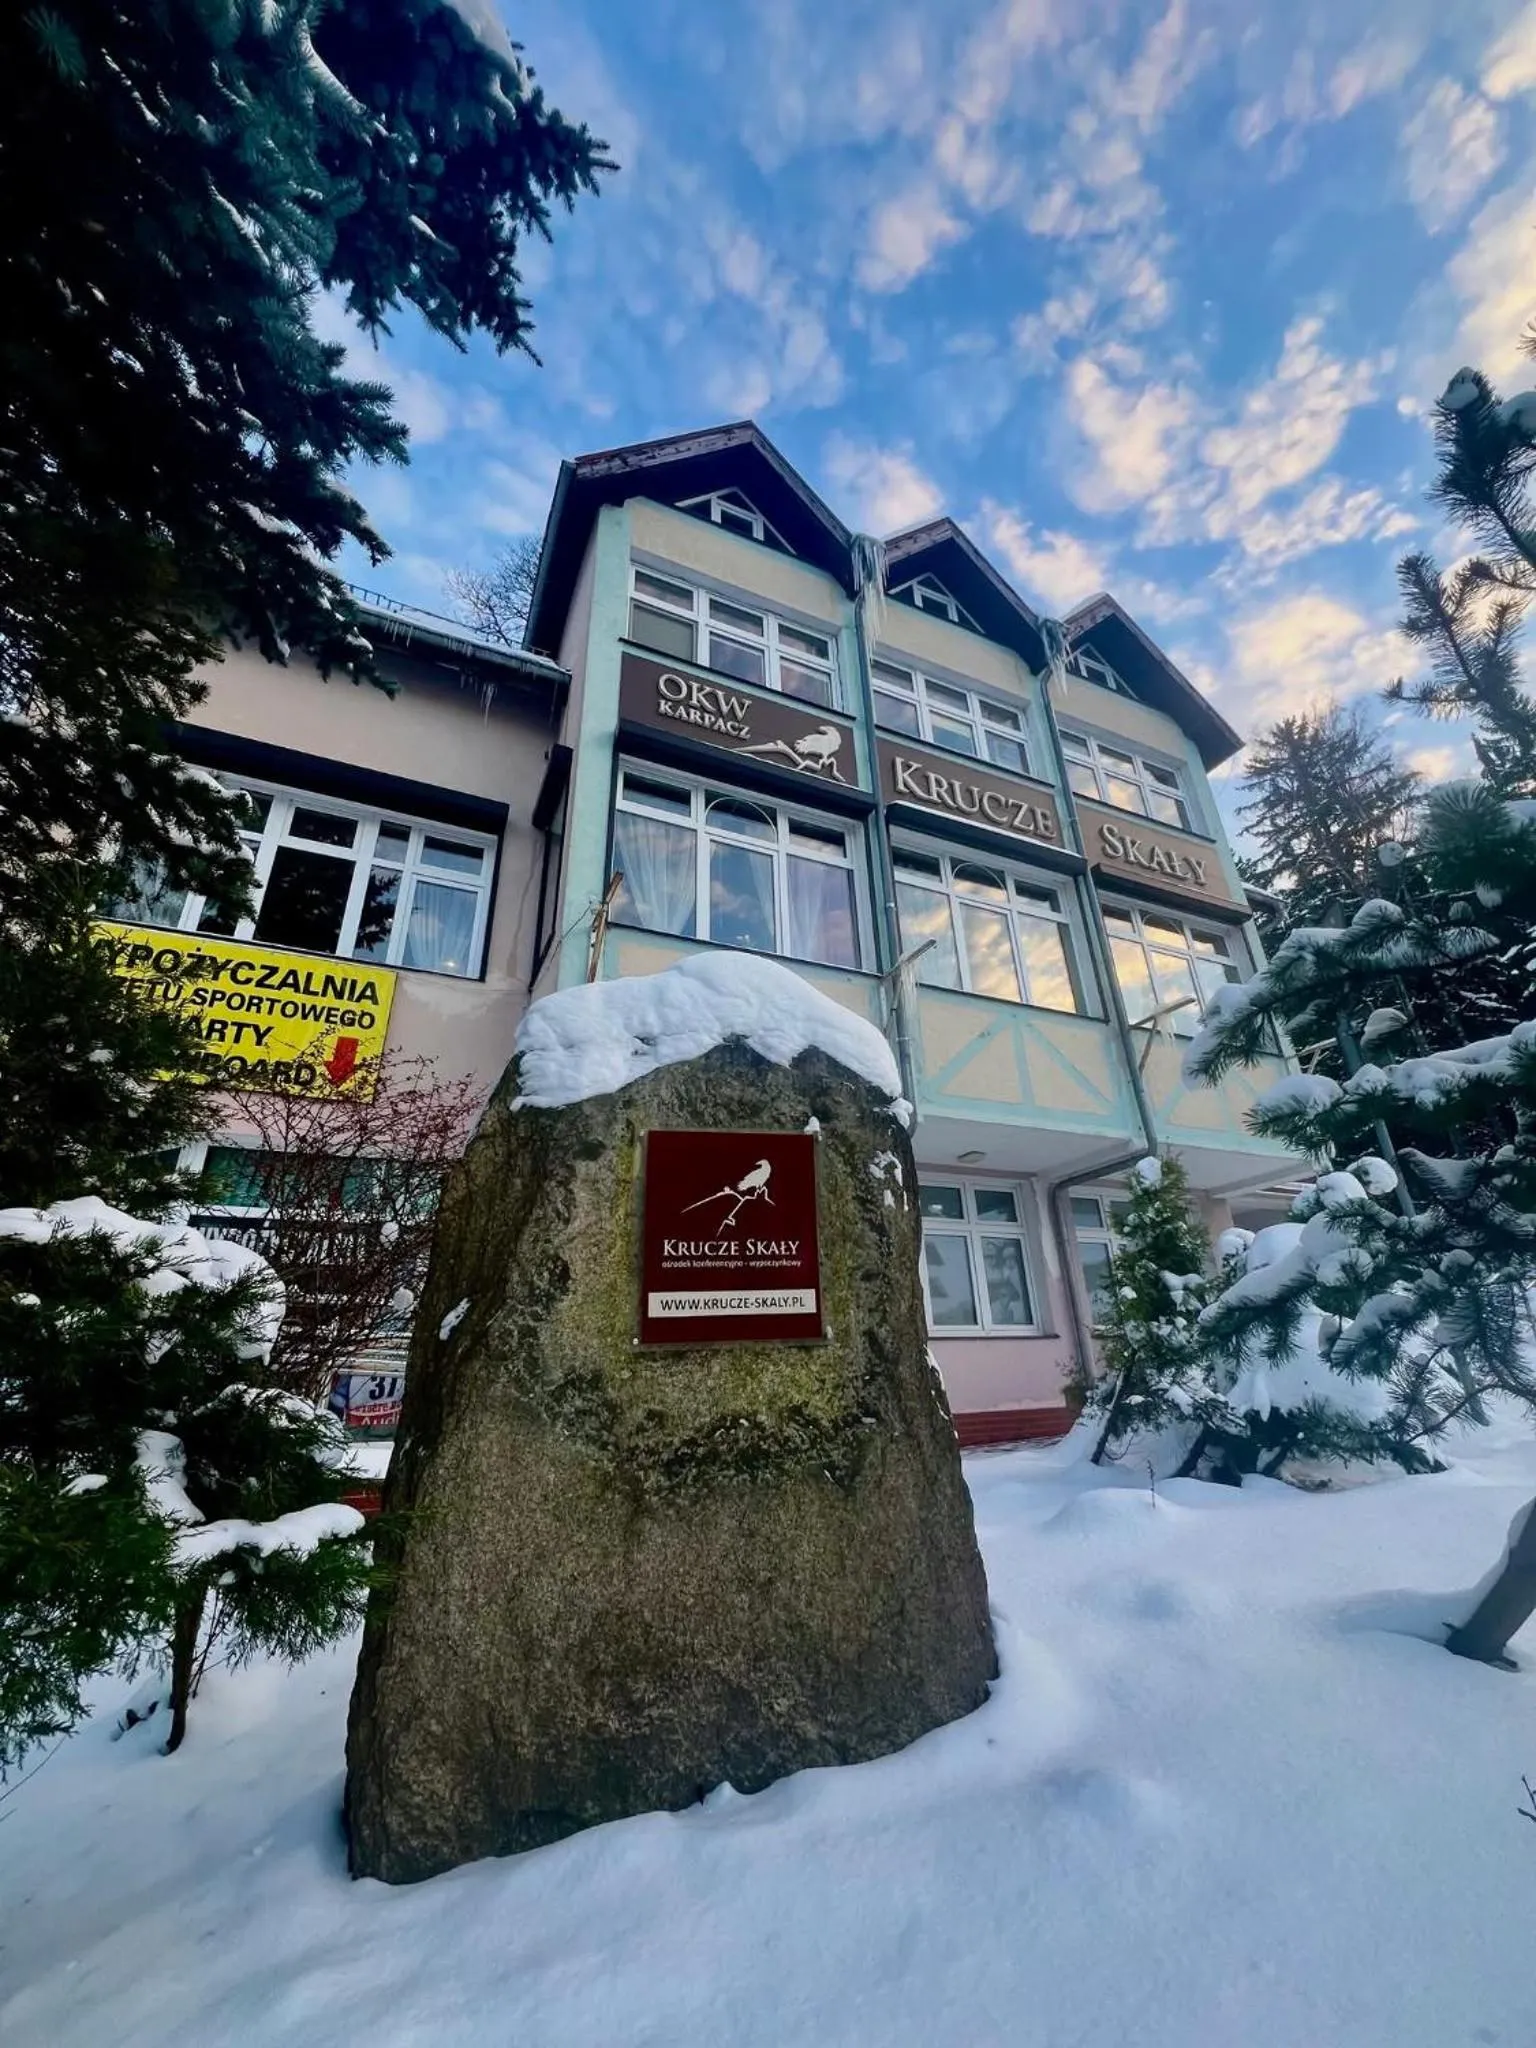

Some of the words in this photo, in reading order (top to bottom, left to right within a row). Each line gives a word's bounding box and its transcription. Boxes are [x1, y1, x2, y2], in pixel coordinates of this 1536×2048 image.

[658, 673, 752, 721] OKW
[658, 699, 751, 739] KARPACZ
[893, 756, 1056, 839] KRUCZE
[1100, 823, 1207, 886] SKAŁY
[95, 939, 380, 1006] YPOŻYCZALNIA
[190, 987, 376, 1030] SPORTOWEGO
[182, 1014, 275, 1047] ARTY
[662, 1259, 691, 1268] ośrodek
[749, 1259, 802, 1269] wypoczynkowy
[663, 1239, 739, 1256] KRUCZE
[746, 1238, 799, 1256] SKAŁY
[660, 1296, 805, 1311] WWW.KRUCZE-SKALY.PL
